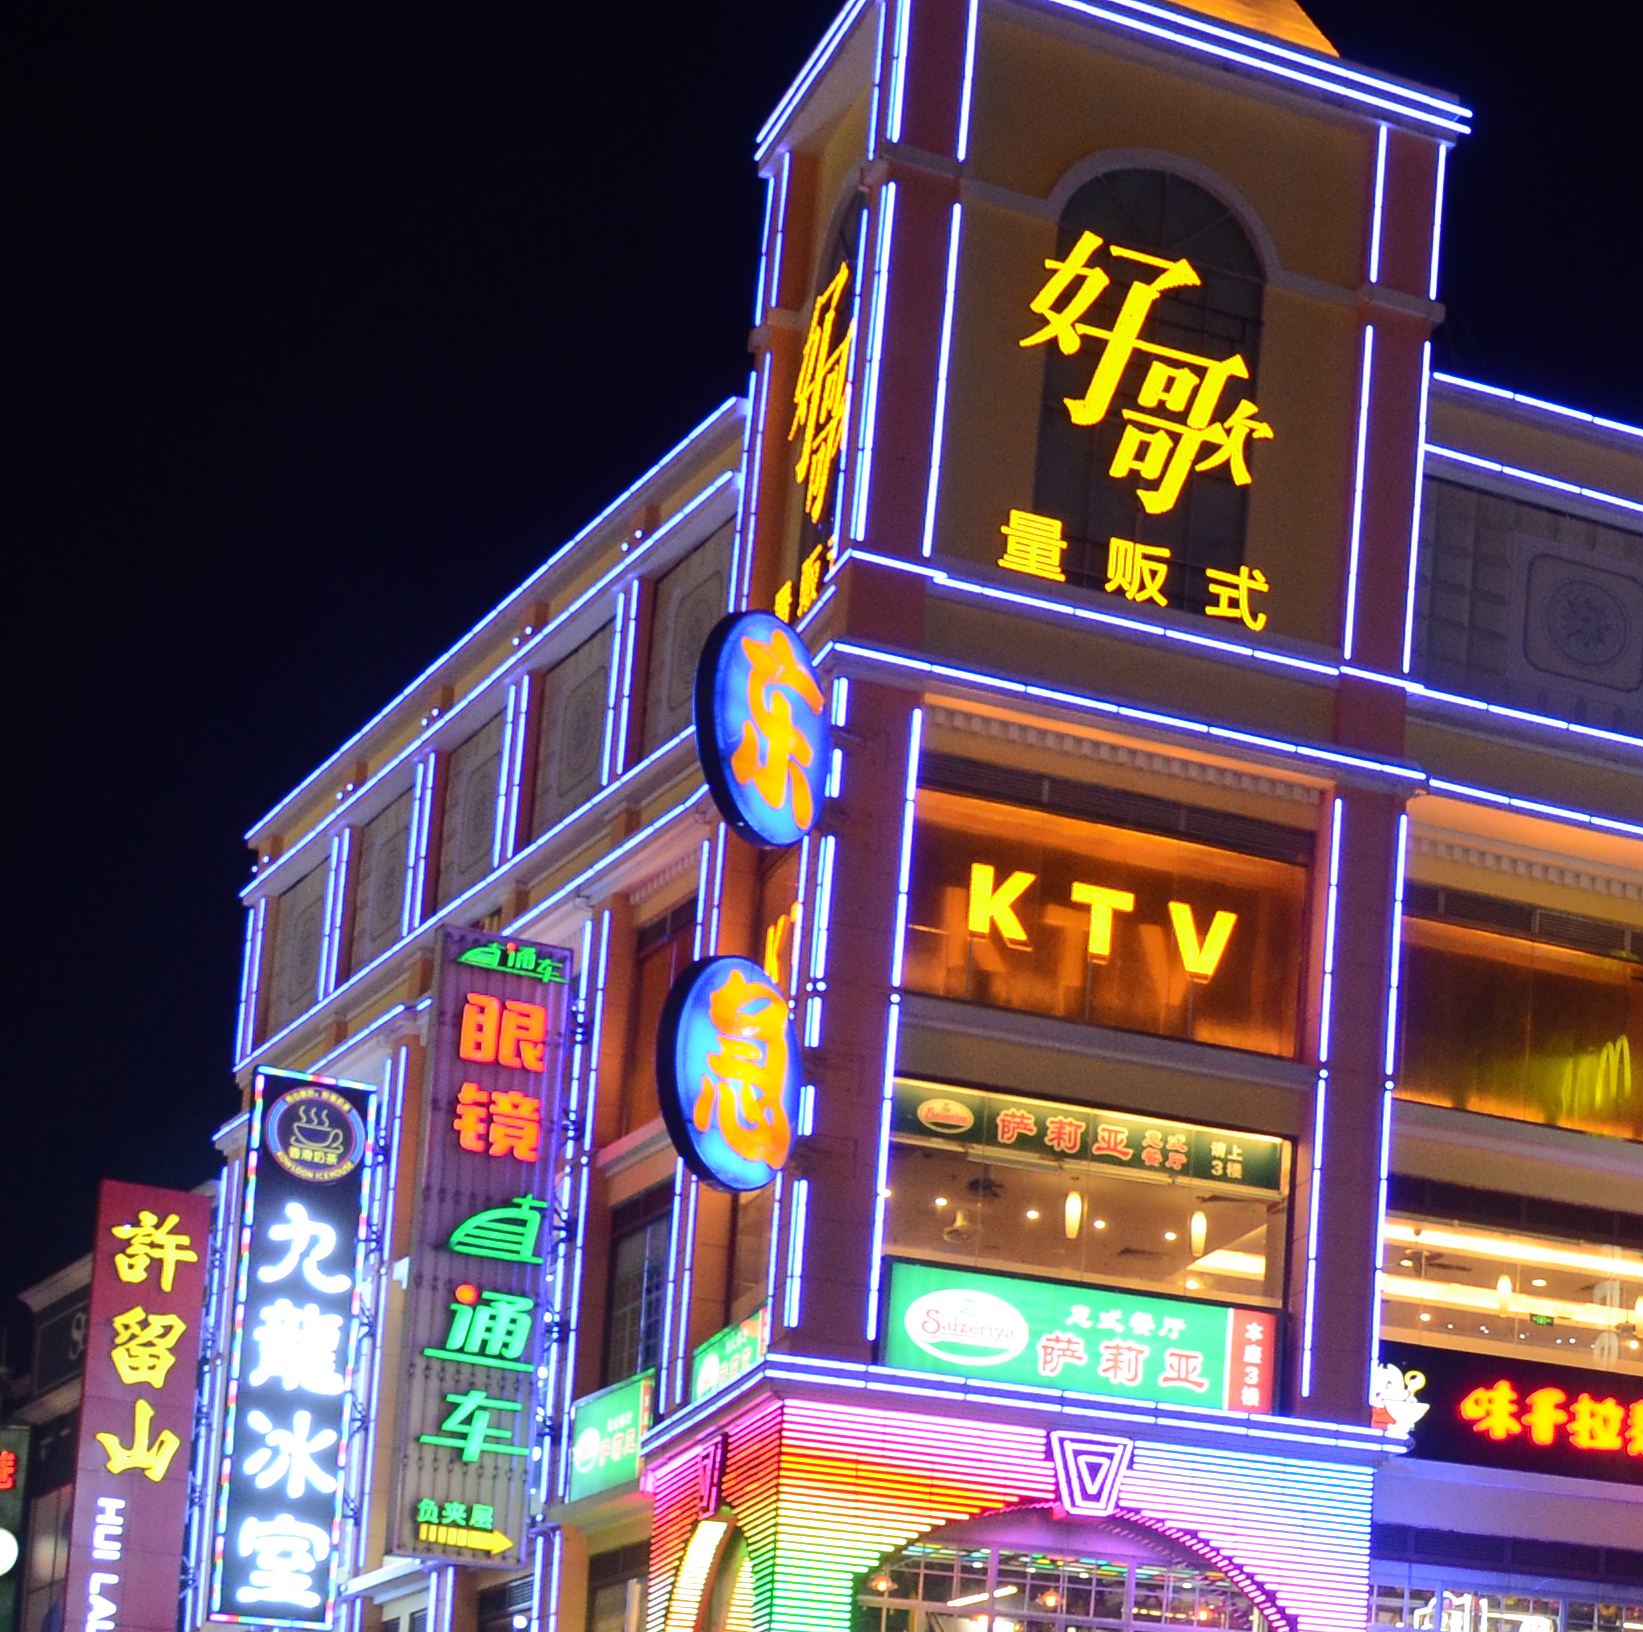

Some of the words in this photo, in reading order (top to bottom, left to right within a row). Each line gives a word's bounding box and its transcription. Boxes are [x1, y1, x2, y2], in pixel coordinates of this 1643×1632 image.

[1019, 230, 1274, 513] 好歌
[997, 509, 1270, 632] 量贩式
[968, 862, 1237, 978] KTV
[453, 992, 548, 1162] 眼镜
[997, 1107, 1135, 1161] 萨莉亚
[1141, 1130, 1190, 1153] 意式
[1141, 1151, 1188, 1171] 餐厅
[96, 1210, 198, 1482] 許留山
[420, 1194, 551, 1463] 直通车
[921, 1308, 1015, 1346] Saizeriya
[1065, 1304, 1186, 1339] 意式餐厅
[1037, 1330, 1210, 1393] 萨莉亚
[235, 1202, 352, 1609] 九龍冰室
[91, 1497, 126, 1562] HUI
[417, 1498, 494, 1531] 负夹层
